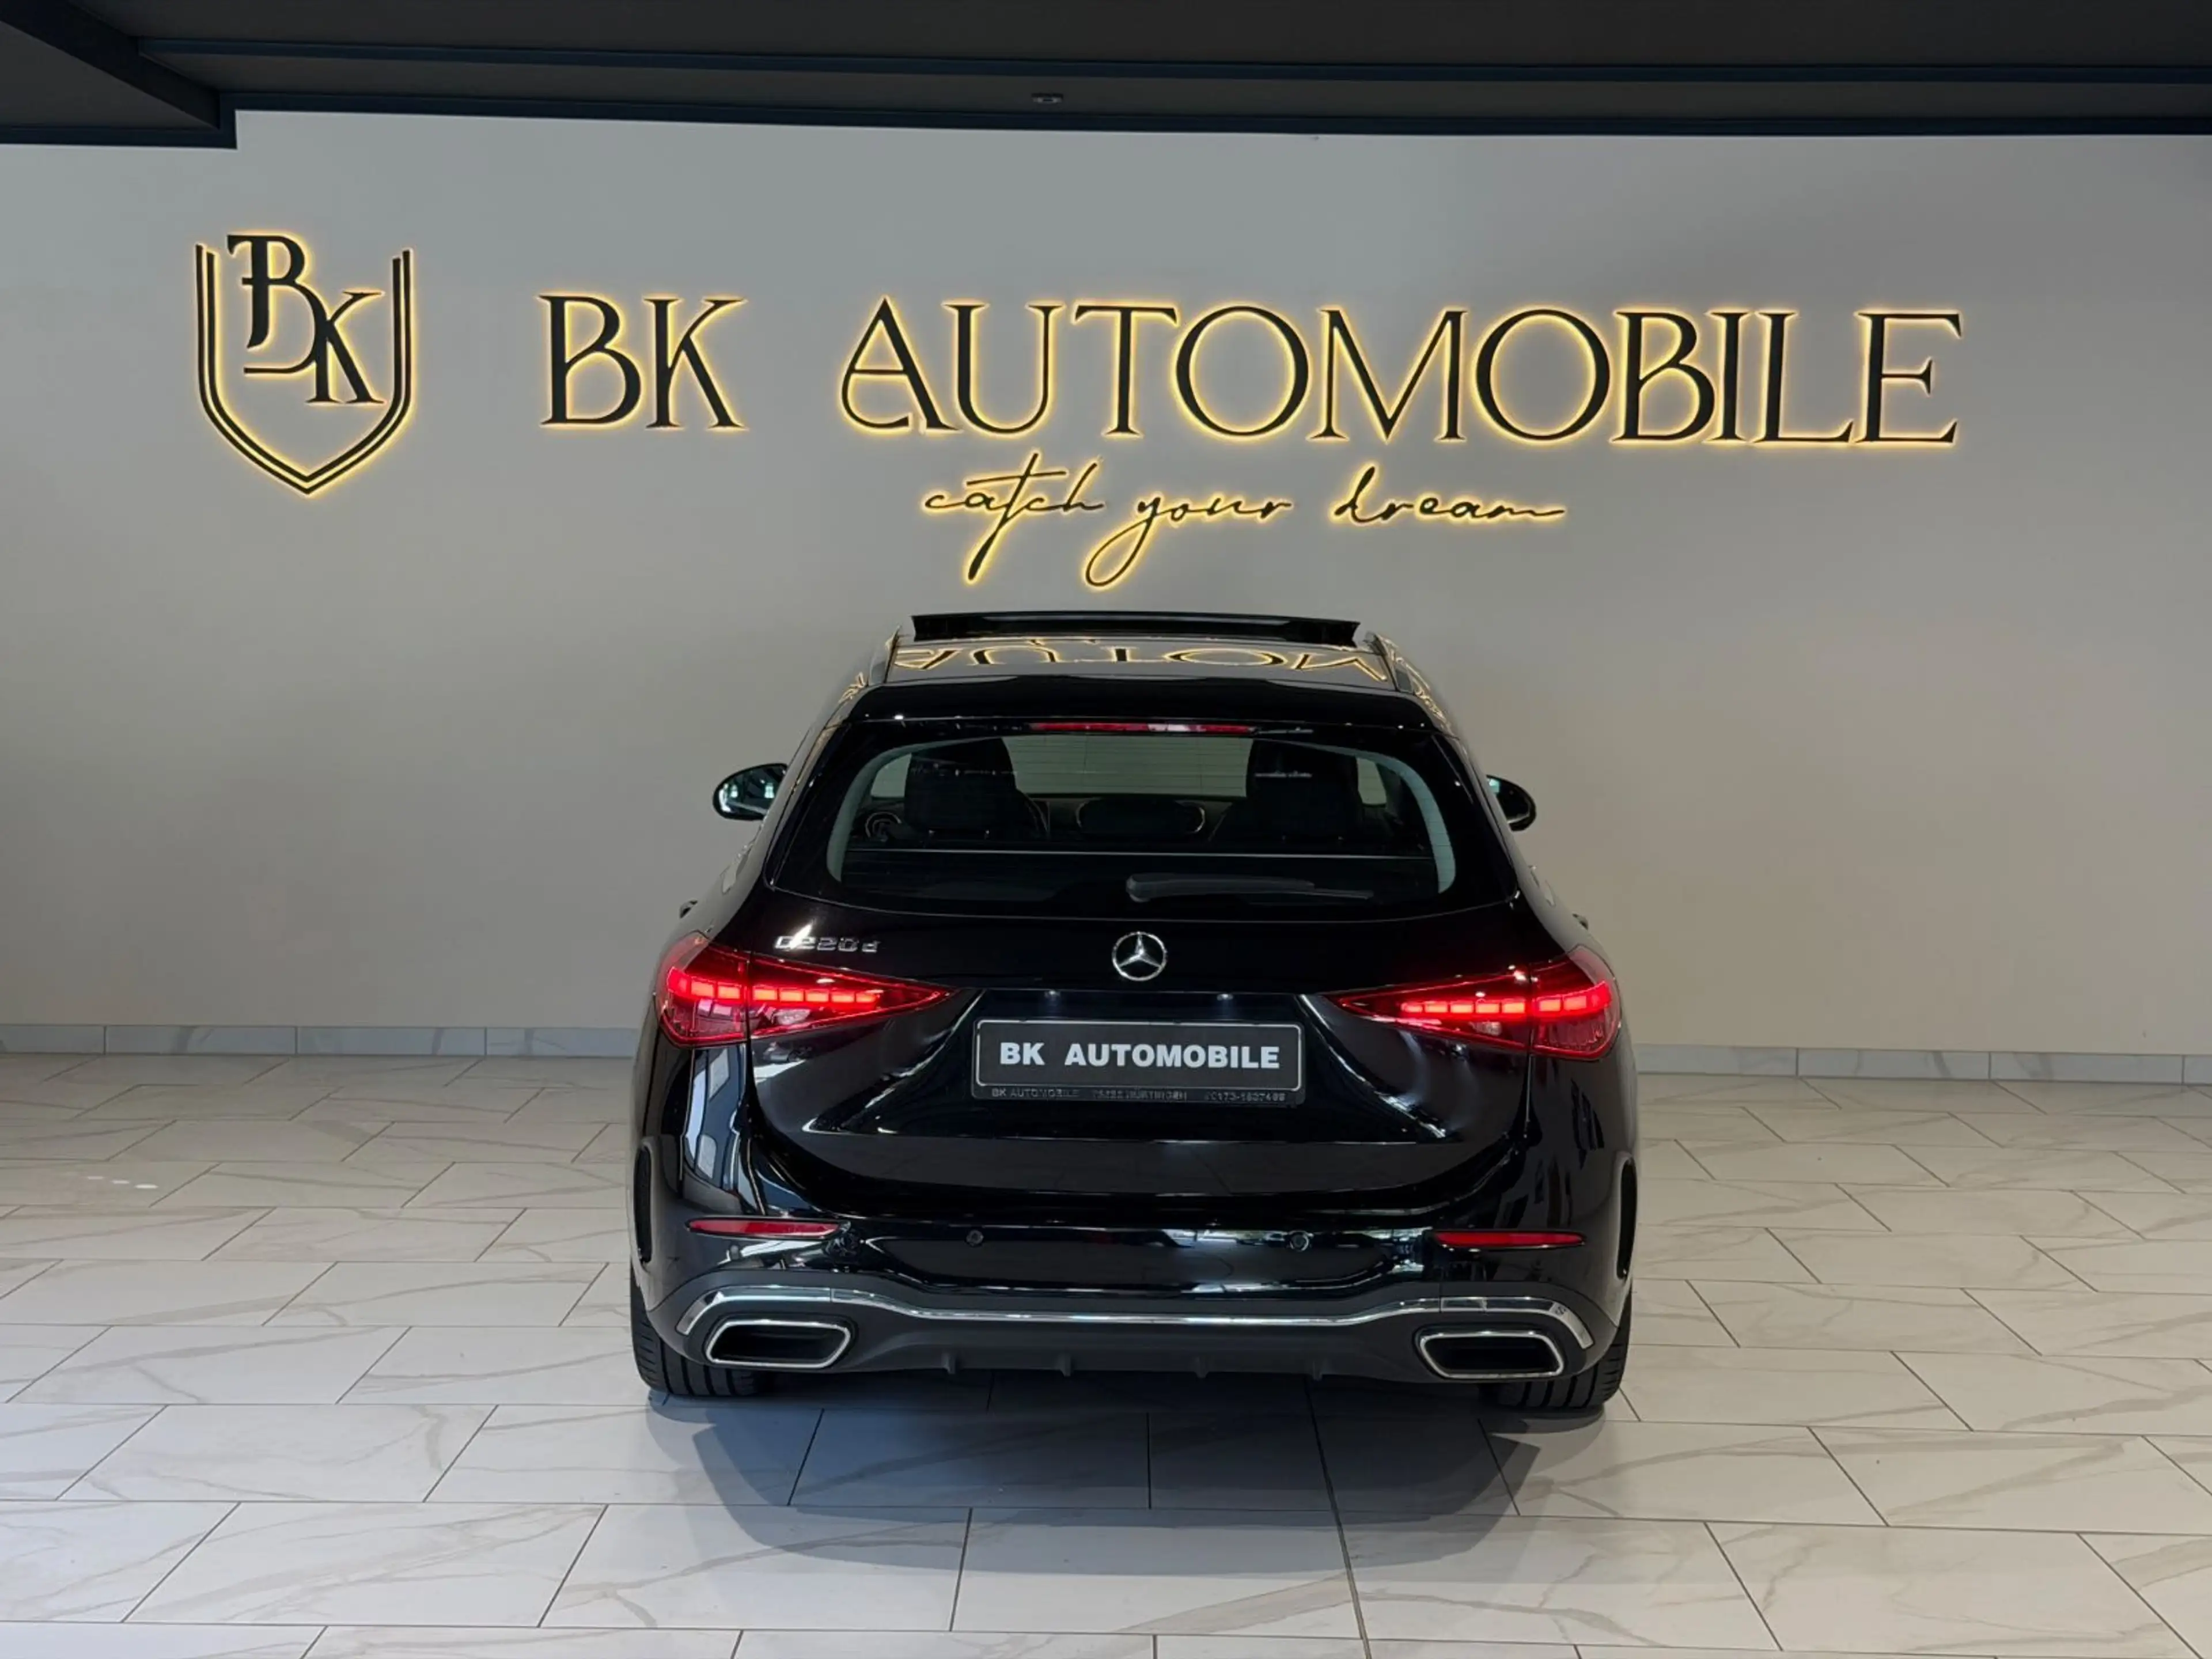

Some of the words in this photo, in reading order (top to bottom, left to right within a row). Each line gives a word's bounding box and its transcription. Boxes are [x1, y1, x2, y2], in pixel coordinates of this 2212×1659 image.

[227, 234, 384, 404] BK
[539, 294, 742, 429] BK
[840, 297, 1963, 446] AUTOMOBILE
[925, 453, 1105, 582] catch
[1085, 494, 1292, 588] your
[1334, 465, 1566, 524] dream
[999, 1042, 1046, 1066] BK
[1064, 1043, 1281, 1069] AUTOMOBILE
